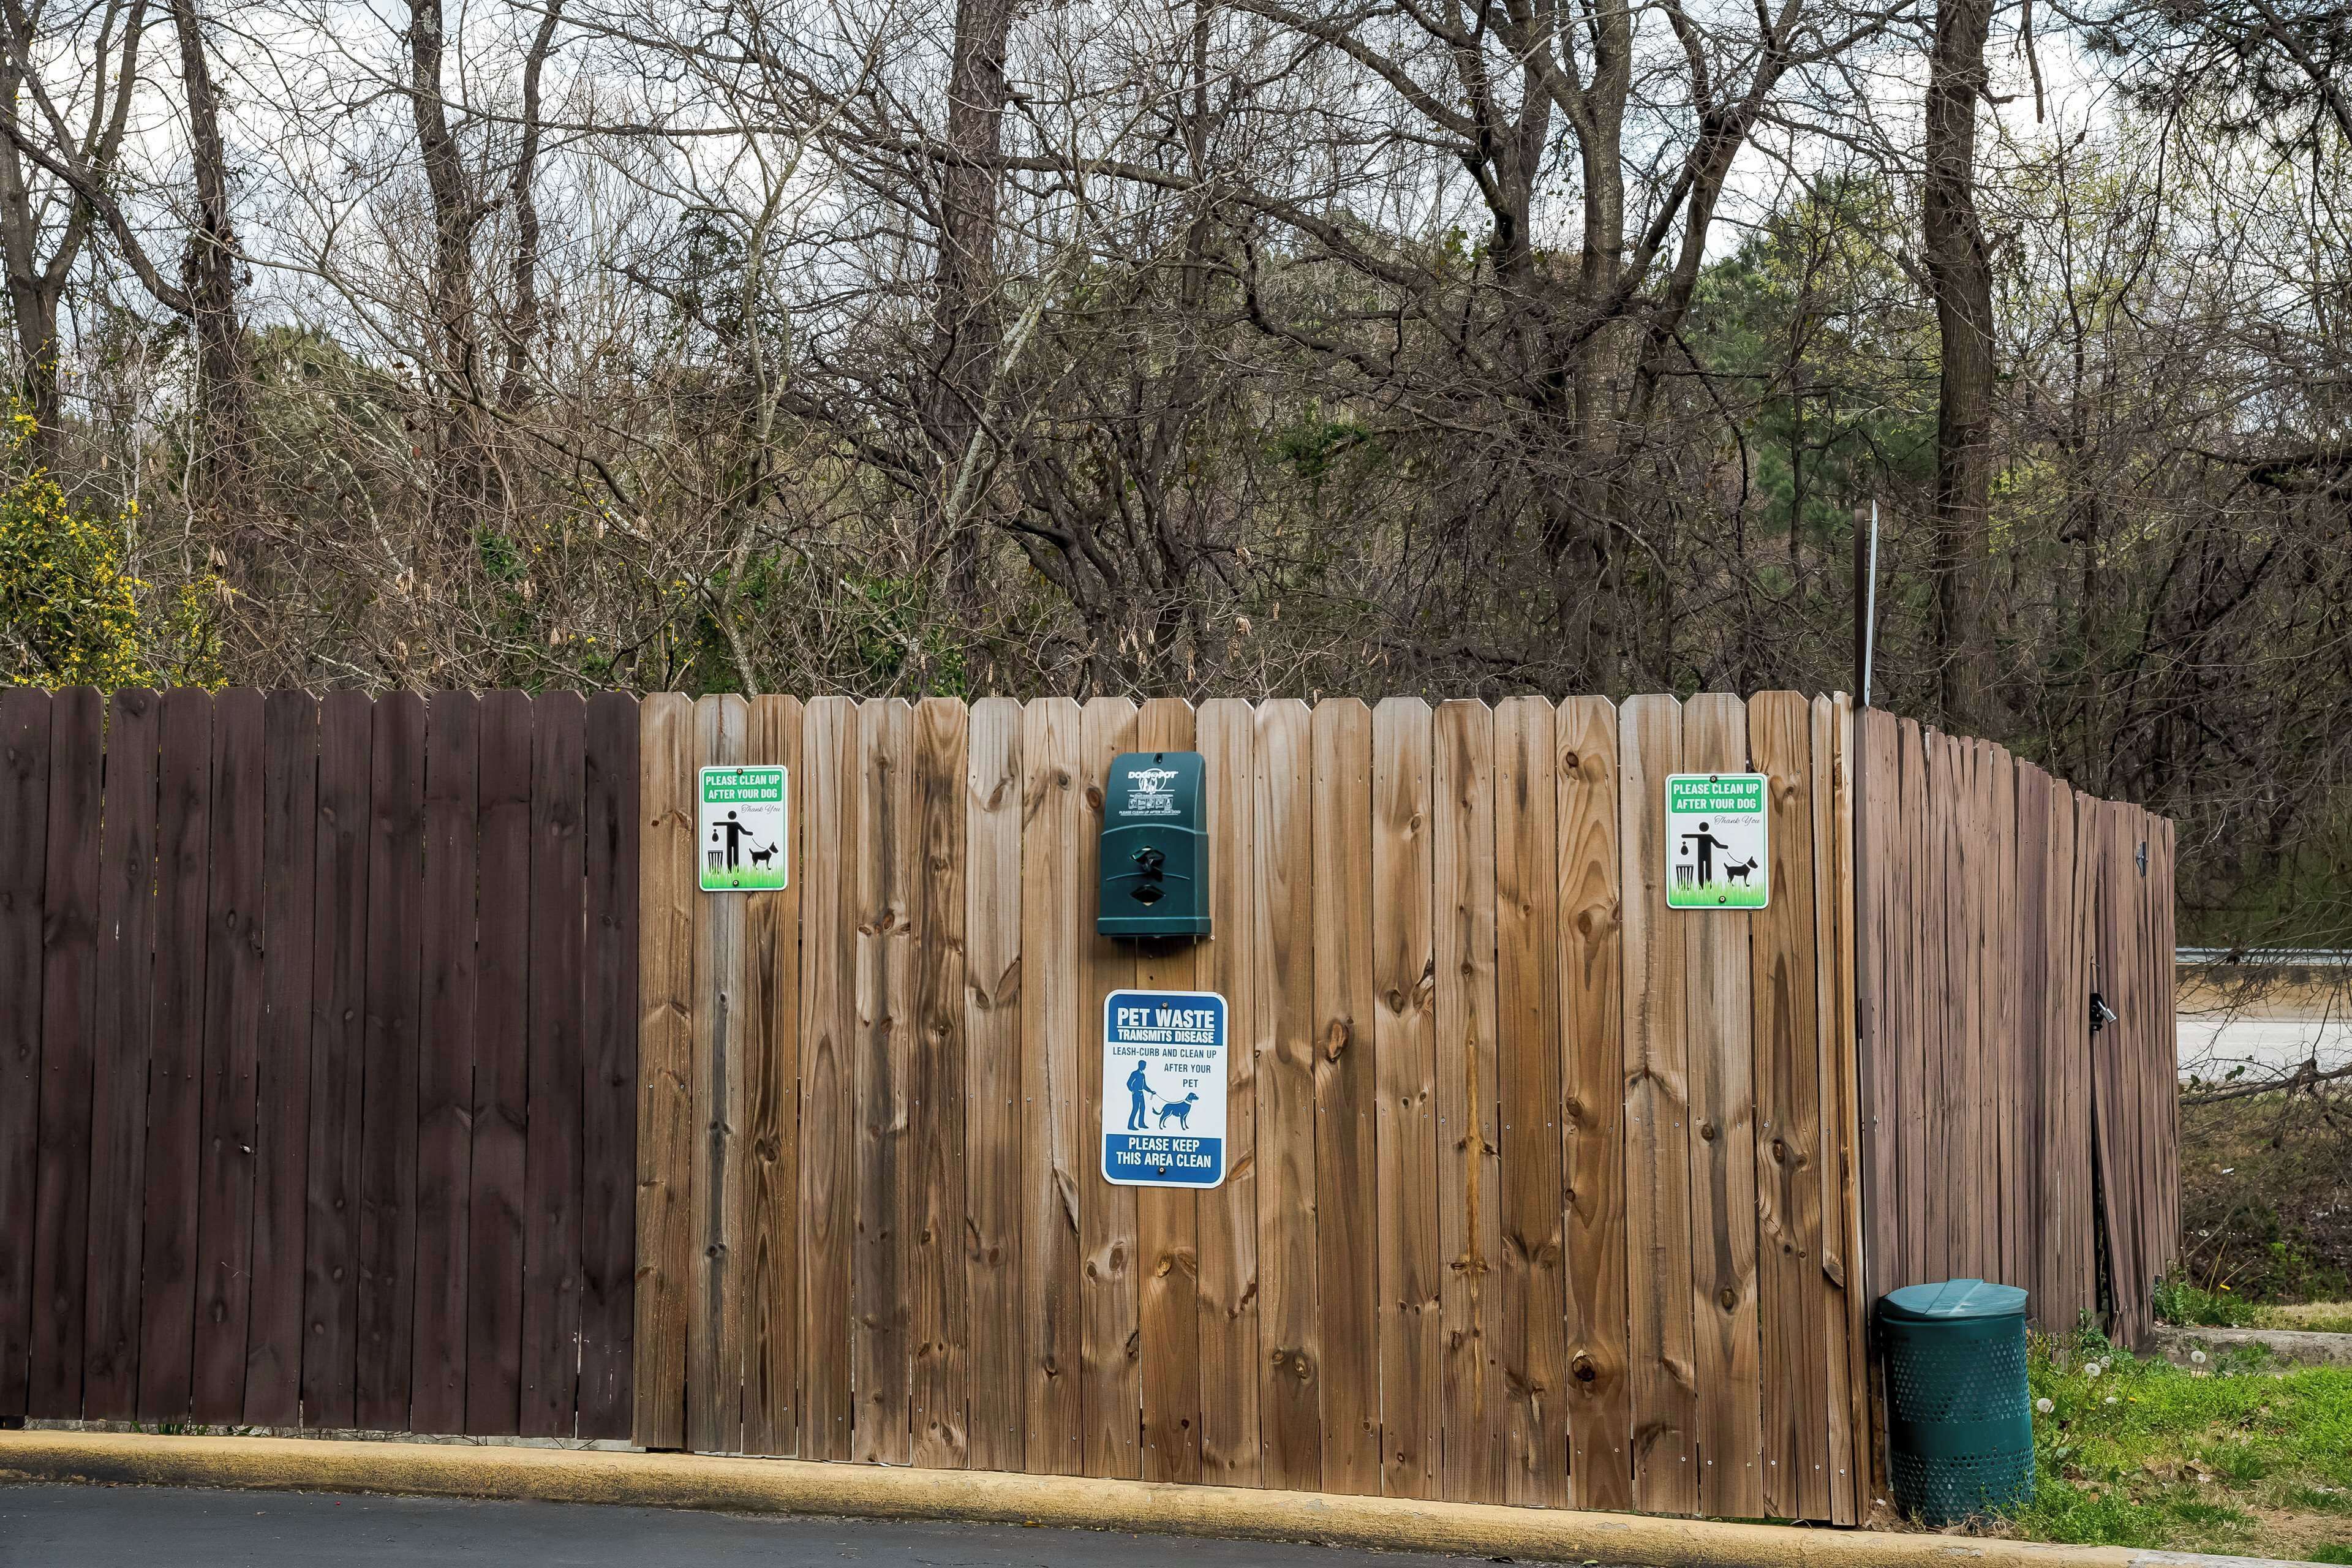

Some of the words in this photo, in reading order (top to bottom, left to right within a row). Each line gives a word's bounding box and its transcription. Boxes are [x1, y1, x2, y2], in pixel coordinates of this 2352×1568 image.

[706, 775, 737, 785] PLEASE
[739, 775, 766, 785] CLEAN
[769, 775, 780, 784] UP
[708, 790, 735, 799] AFTER
[737, 789, 759, 799] YOUR
[761, 789, 777, 798] DOG
[1673, 784, 1709, 794] PLEASE
[1711, 783, 1743, 794] CLEAN
[1746, 783, 1759, 794] UP
[741, 804, 763, 813] Thank
[764, 804, 780, 814] You
[1676, 799, 1706, 809] AFTER
[1709, 799, 1735, 809] YOUR
[1737, 799, 1756, 809] DOG
[1714, 815, 1740, 825] Thank
[1742, 815, 1760, 826] You
[1117, 1008, 1150, 1026] PET
[1155, 1009, 1215, 1028] WASTE
[1118, 1029, 1172, 1042] TRANSMITS
[1175, 1031, 1214, 1043] DISEASE
[1113, 1047, 1159, 1057] LEASH-CURB
[1163, 1049, 1177, 1057] AND
[1180, 1049, 1204, 1058] CLEAN
[1207, 1050, 1216, 1058] UP
[1164, 1063, 1188, 1072] AFTER
[1191, 1065, 1211, 1073] YOUR
[1128, 1137, 1169, 1151] PLEASE
[1172, 1139, 1200, 1152] KEEP
[1116, 1152, 1141, 1164] THIS
[1144, 1153, 1173, 1166] AREA
[1177, 1155, 1211, 1167] CLEAN
